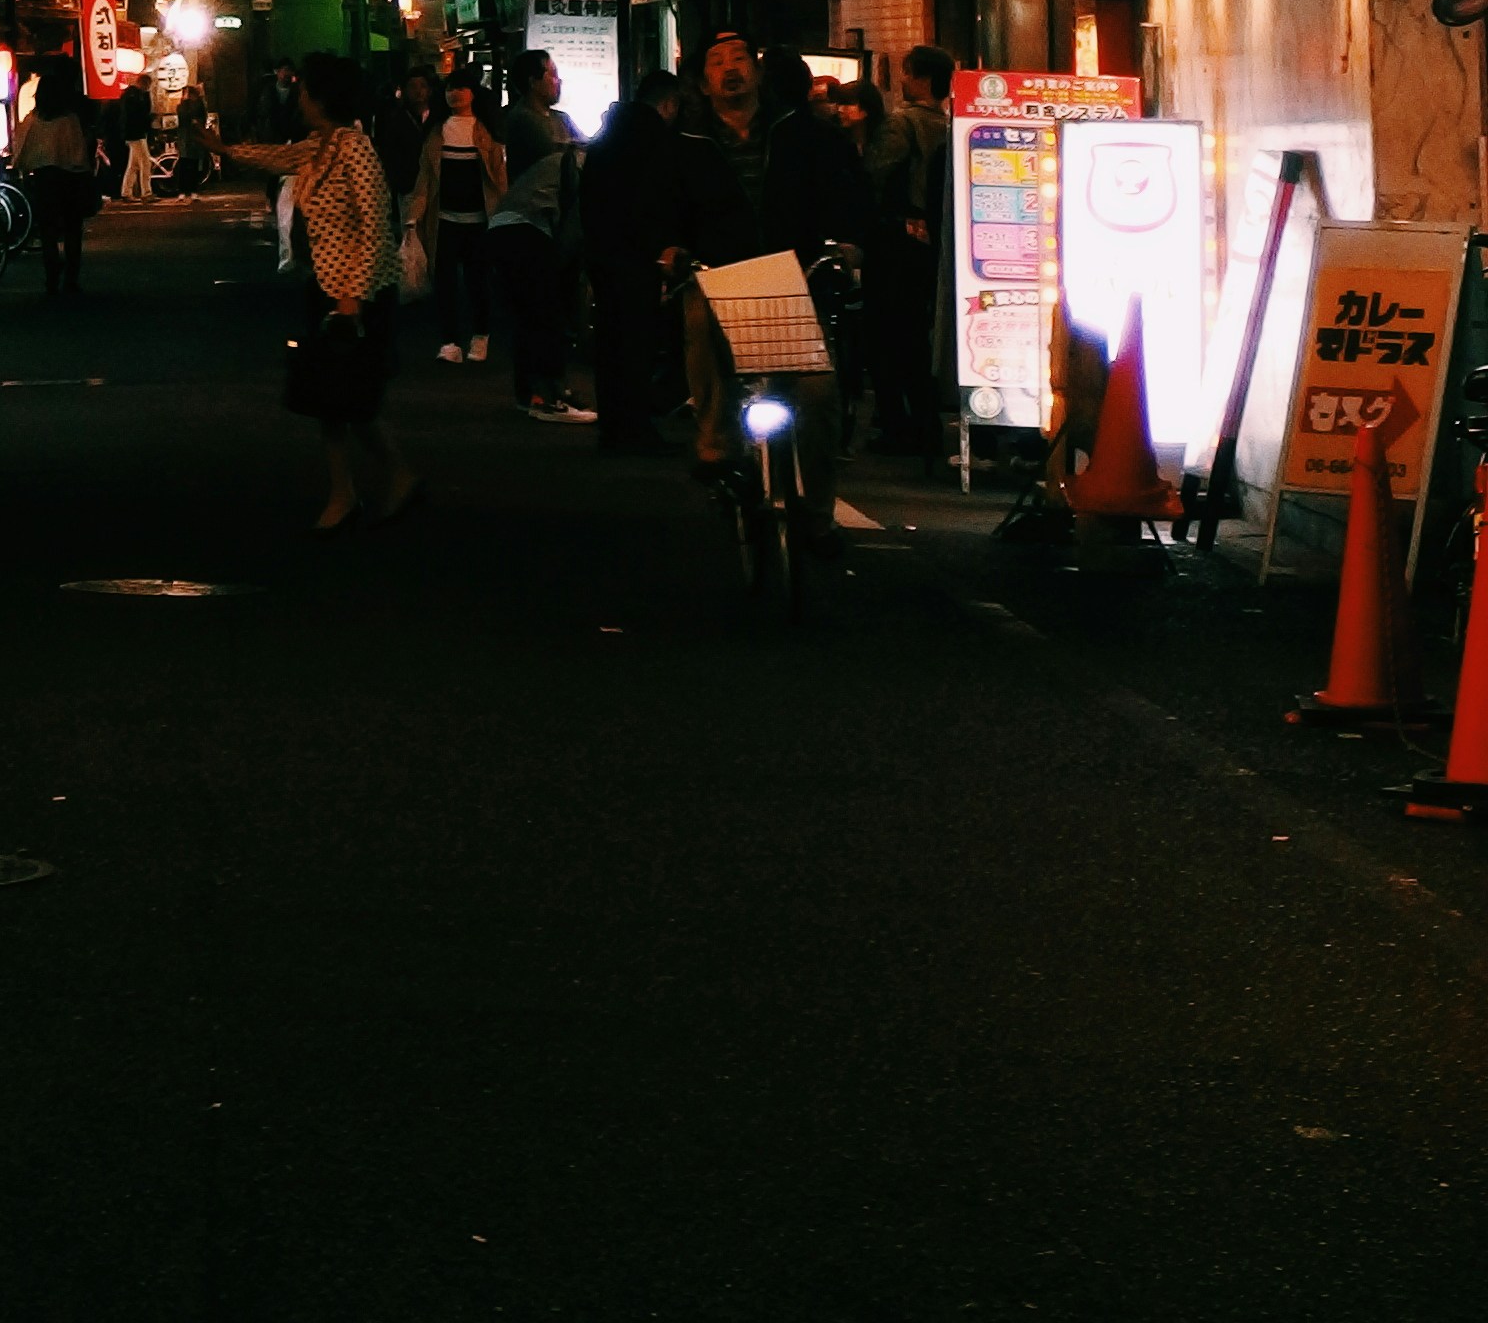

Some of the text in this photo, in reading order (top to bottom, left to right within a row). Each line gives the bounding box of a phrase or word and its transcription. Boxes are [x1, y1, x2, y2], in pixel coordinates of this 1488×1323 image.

[1334, 289, 1425, 327] カレー
[1316, 327, 1436, 366] マドラス
